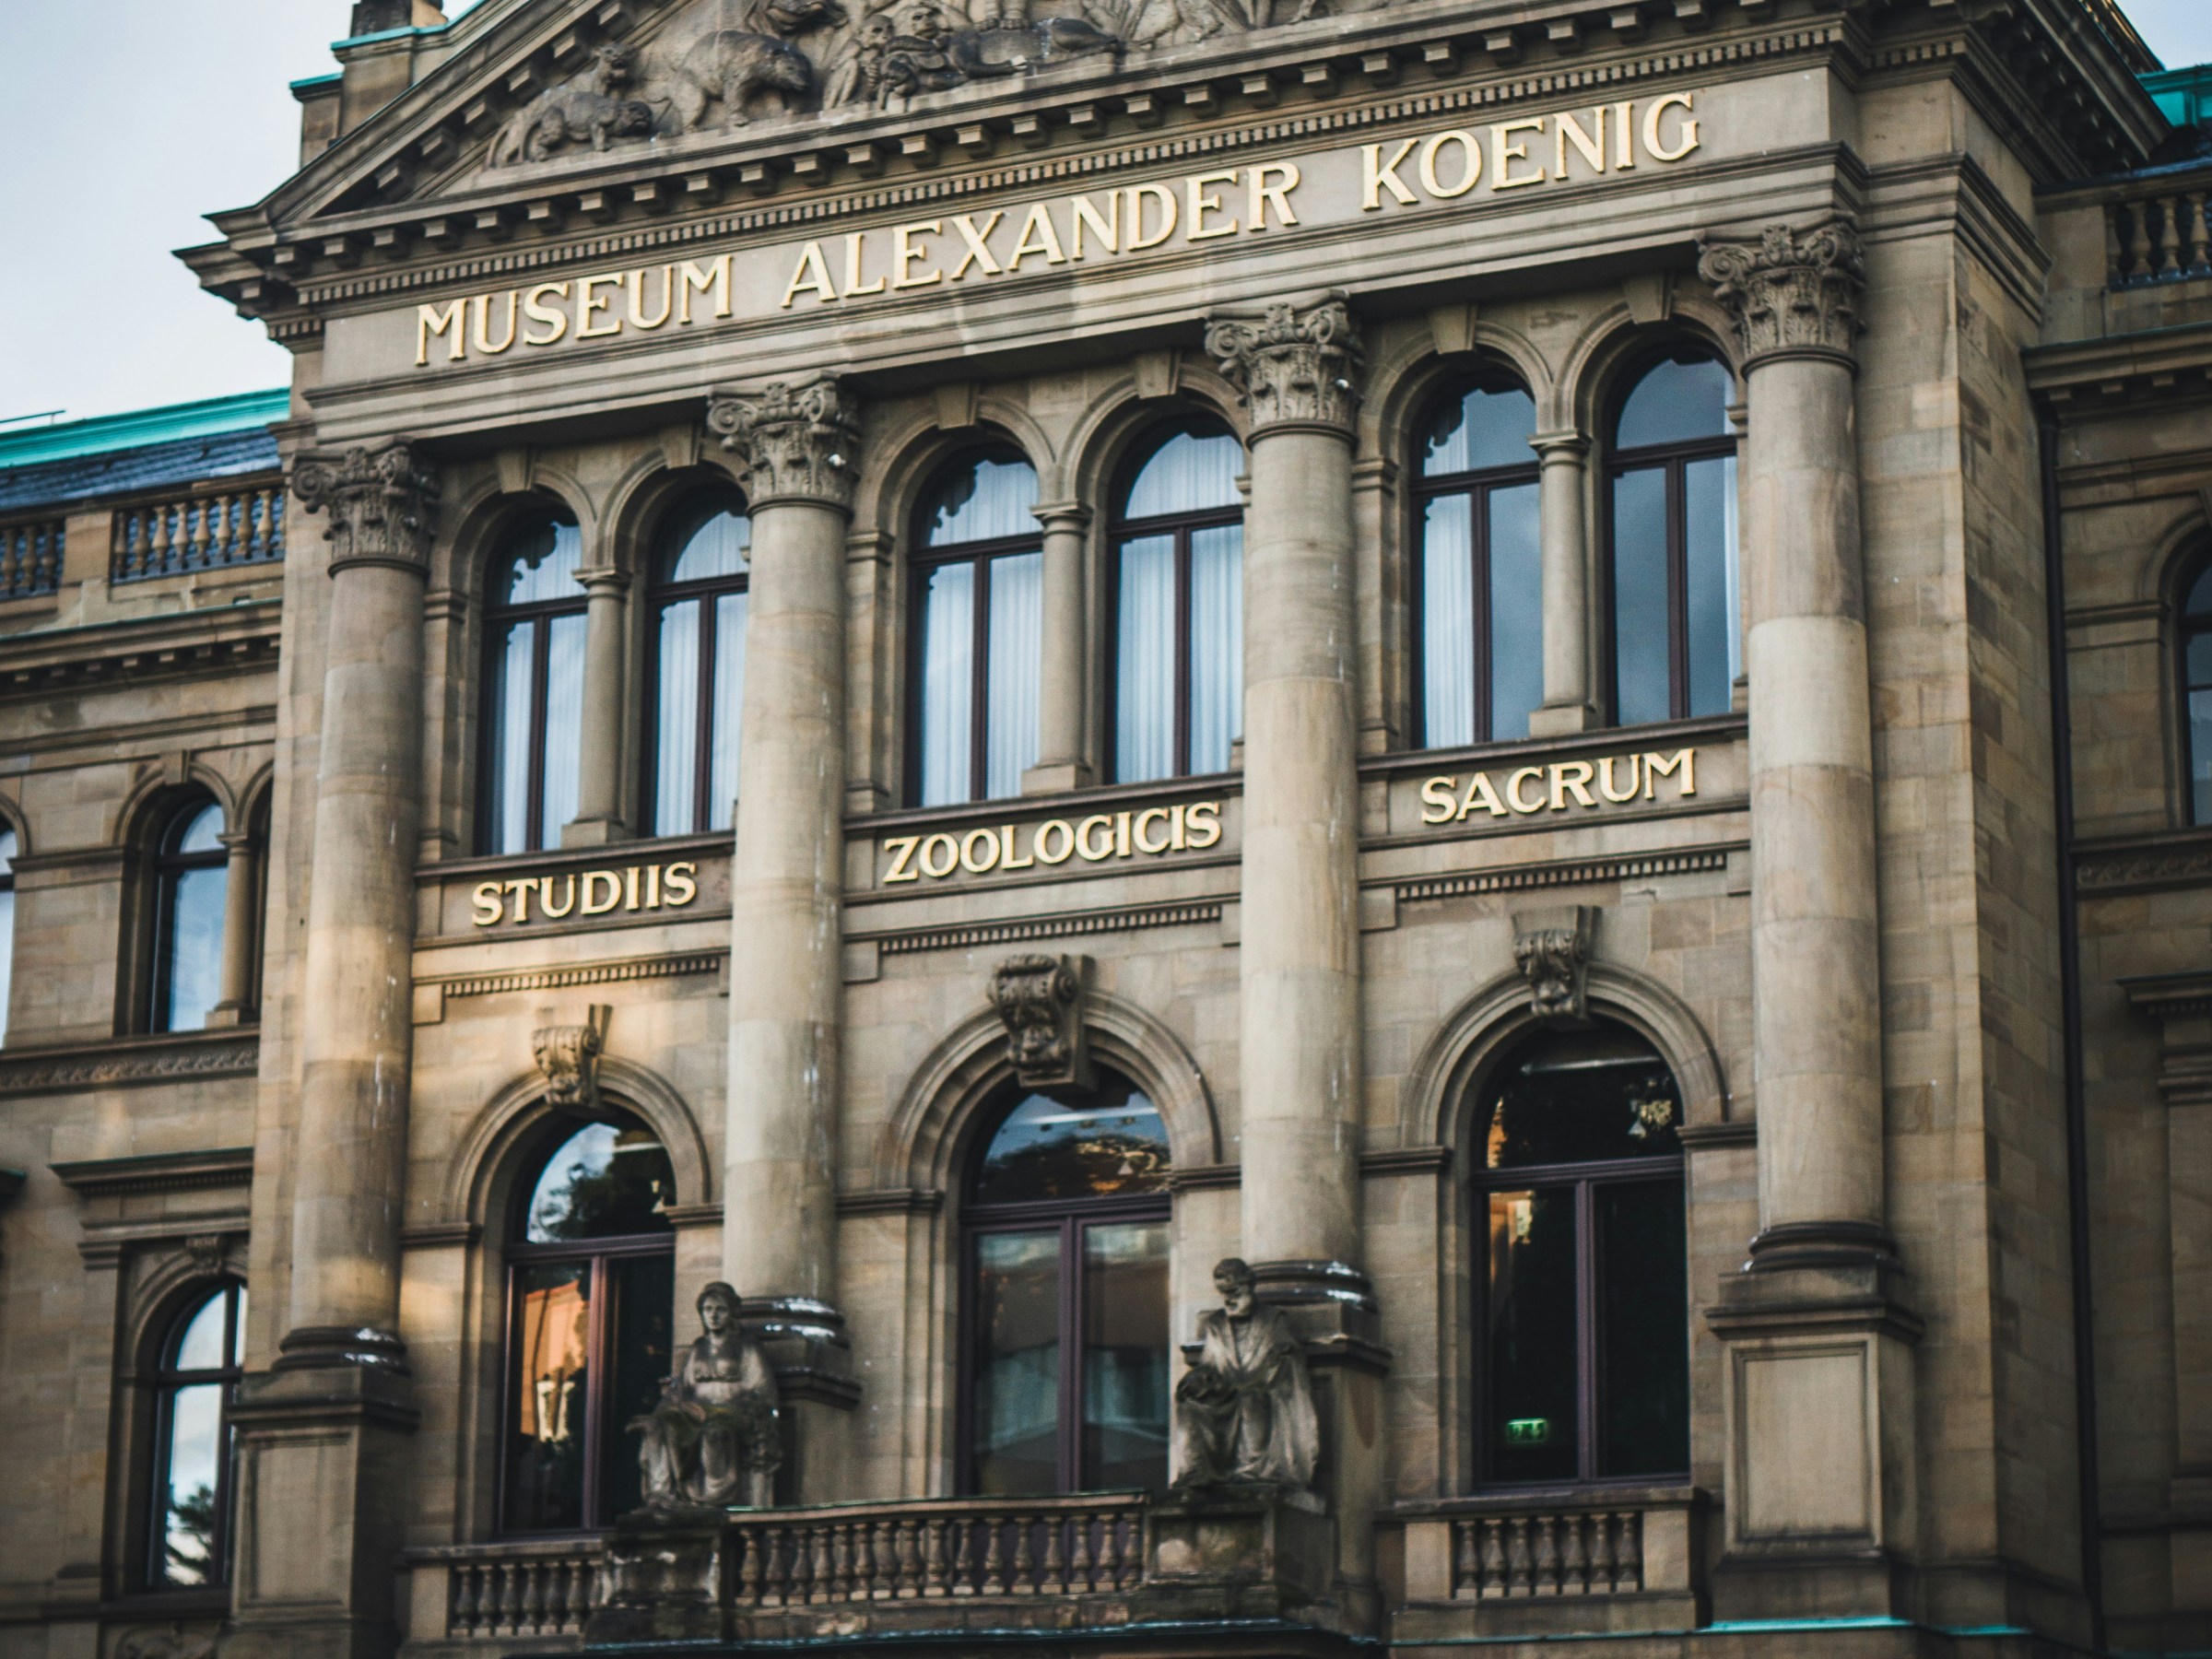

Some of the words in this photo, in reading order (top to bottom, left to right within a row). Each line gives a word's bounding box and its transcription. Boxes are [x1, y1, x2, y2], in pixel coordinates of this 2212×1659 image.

[413, 253, 734, 366] MUSEUM
[781, 159, 1300, 309] ALEXANDER
[1359, 91, 1701, 212] KOENIG
[1420, 747, 1696, 823] SACRUM
[883, 801, 1222, 883] ZOOLOGICIS
[471, 860, 697, 926] STUDIIS
